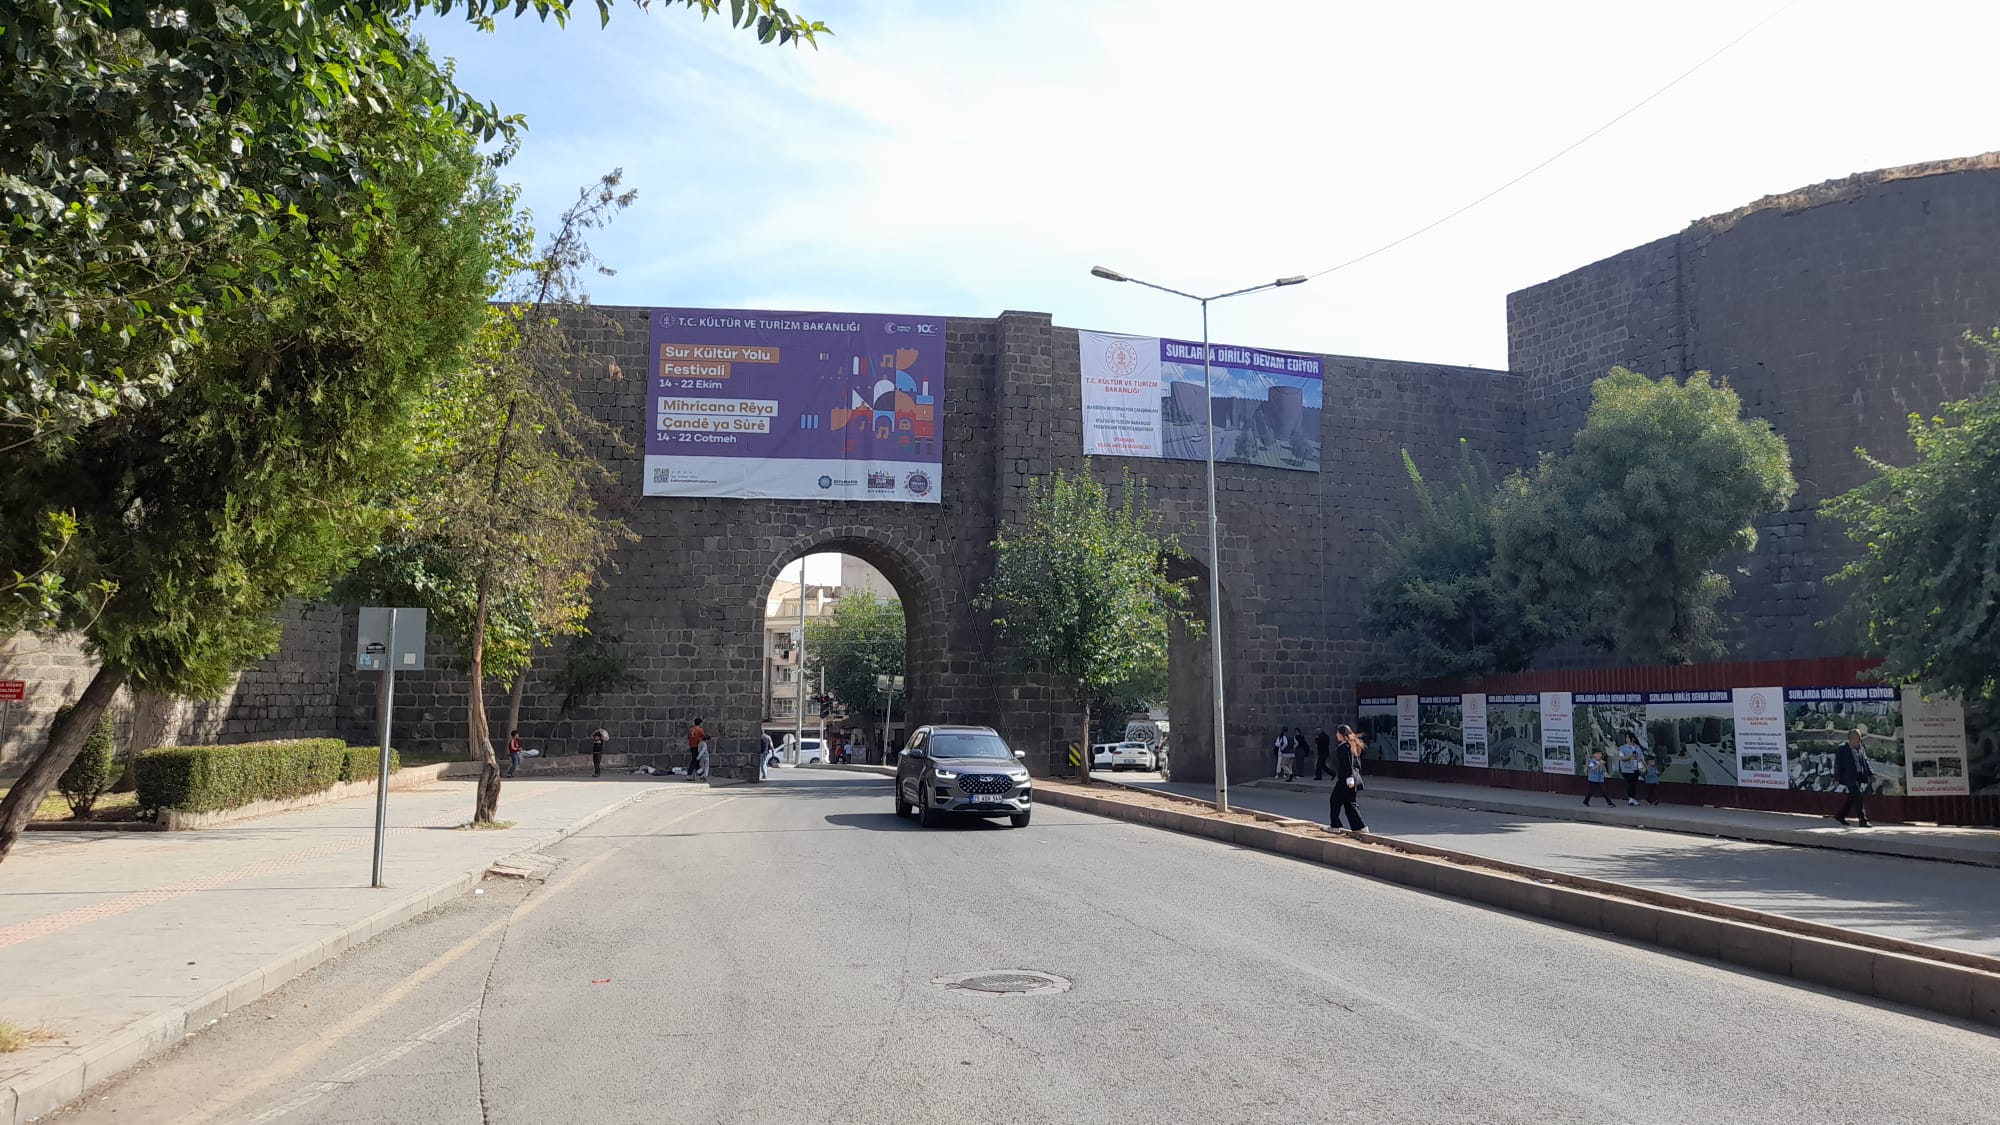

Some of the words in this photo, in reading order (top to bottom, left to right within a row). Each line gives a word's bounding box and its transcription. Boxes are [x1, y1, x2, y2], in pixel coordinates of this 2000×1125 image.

[679, 318, 697, 327] T.C.
[699, 317, 741, 328] KÜLTÜR
[743, 319, 757, 329] VE
[759, 319, 800, 330] TURİZM
[802, 321, 860, 332] BAKANLIĞI
[665, 346, 690, 357] Sur
[693, 347, 738, 359] Kültür
[741, 348, 771, 360] Yolu
[1166, 343, 1215, 361] SURLARA
[1218, 347, 1251, 366] DİRİLİŞ
[1253, 352, 1285, 369] DEVAM
[1287, 355, 1319, 374] EDİYOR
[664, 363, 725, 376] Festivali
[659, 379, 672, 388] 14
[680, 379, 694, 389] 22
[695, 379, 722, 389] Ekim
[1098, 377, 1123, 386] KÜLTÜR
[662, 399, 736, 412] Mîhrîcana
[739, 402, 774, 415] Rêya
[662, 417, 709, 431] Çandê
[713, 421, 730, 431] ya
[733, 418, 766, 431] Sûrê
[656, 432, 670, 441] 14
[678, 433, 692, 442] 22
[693, 433, 737, 443] Cotmeh
[1788, 689, 1821, 699] SURLARDA
[1821, 687, 1844, 700] DİRİLİŞ
[1844, 688, 1868, 699] DEVAM
[1868, 686, 1894, 698] EDİYOR
